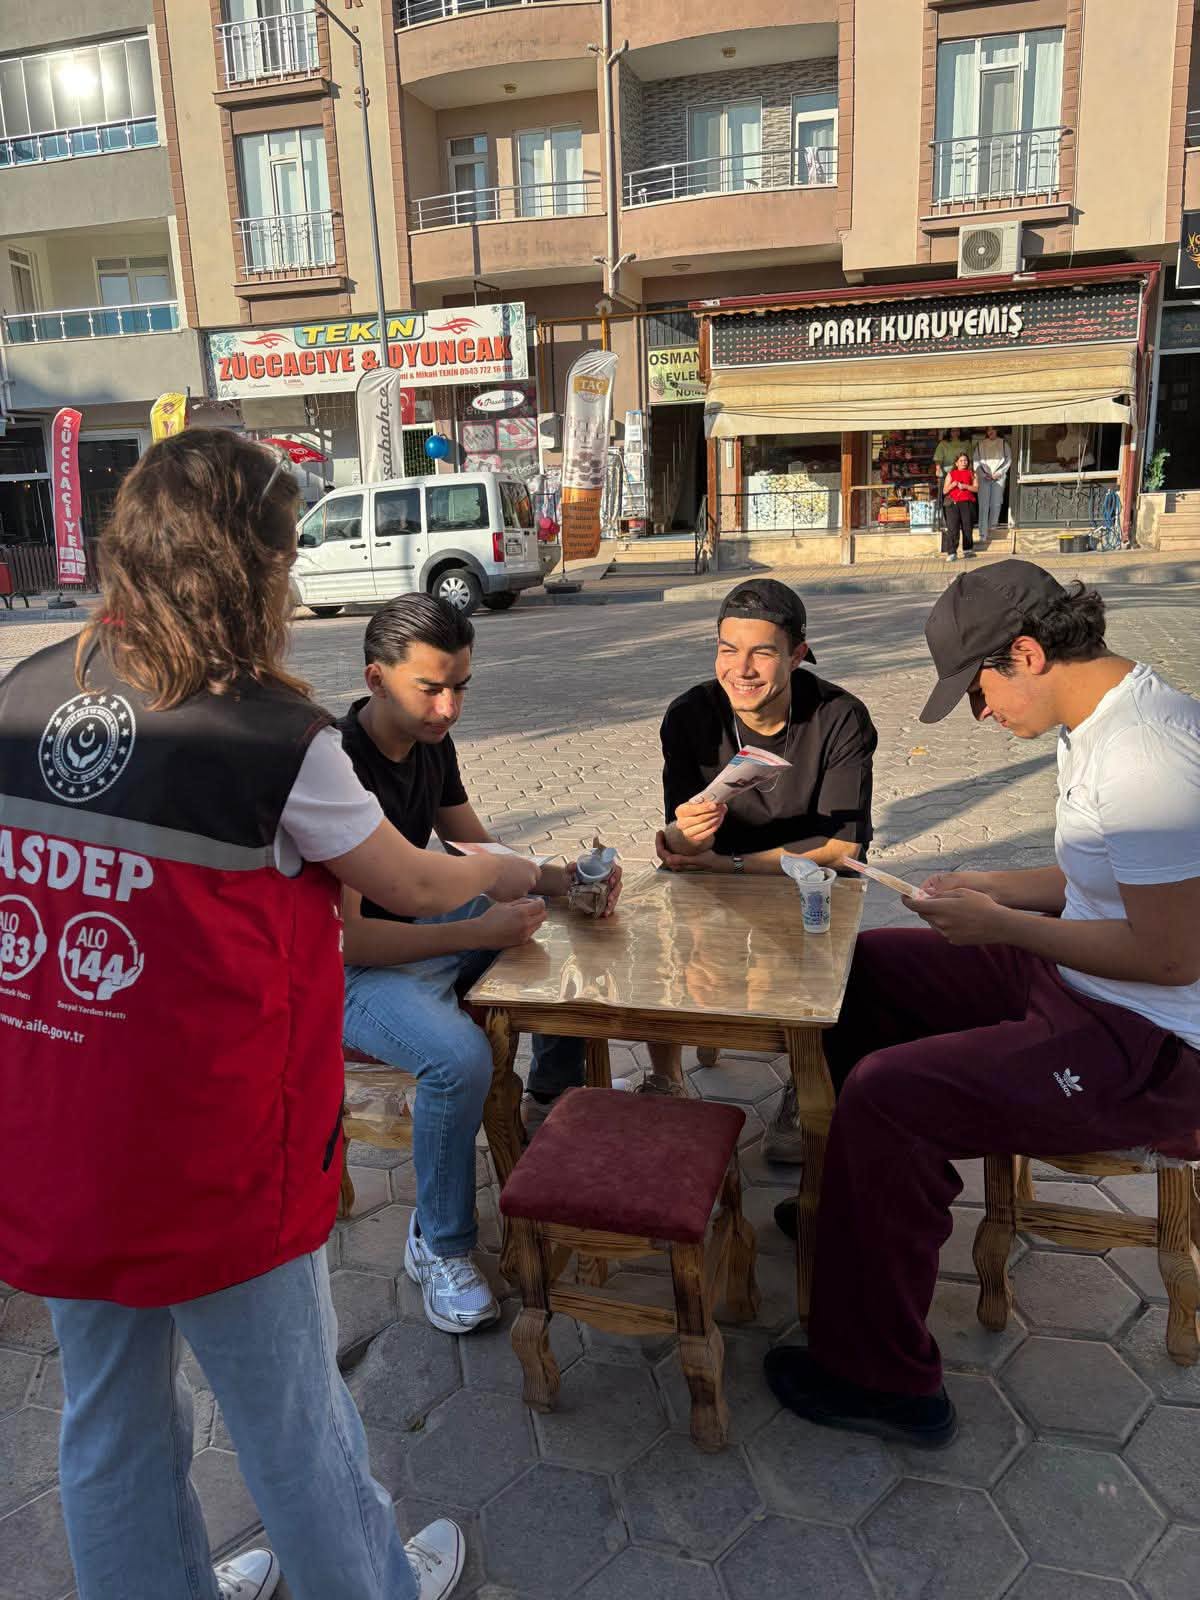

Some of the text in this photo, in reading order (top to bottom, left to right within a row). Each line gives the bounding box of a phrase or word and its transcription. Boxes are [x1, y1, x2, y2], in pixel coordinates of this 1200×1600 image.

[303, 317, 416, 345] TEKN
[808, 305, 1023, 347] PARK KURUYEMİŞ
[218, 335, 513, 381] ZÜCCACİYE & OYUNCAK
[0, 933, 30, 968] 83
[76, 926, 108, 949] ALO
[67, 948, 124, 986] 144
